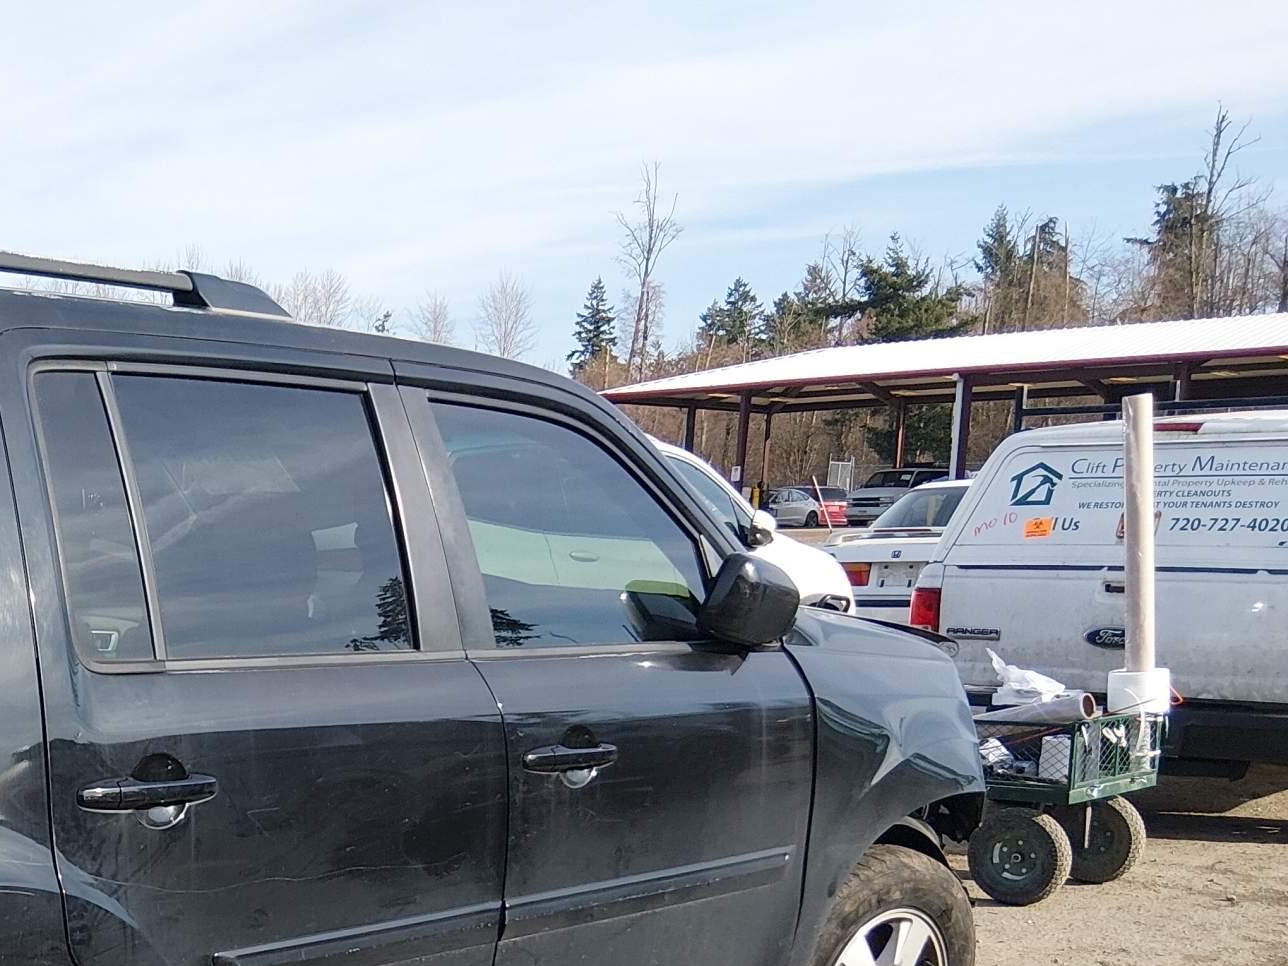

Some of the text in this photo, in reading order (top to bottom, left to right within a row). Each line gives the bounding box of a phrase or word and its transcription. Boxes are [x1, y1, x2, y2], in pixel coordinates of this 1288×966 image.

[1071, 458, 1108, 474] Clift
[1112, 458, 1187, 475] Perty
[1172, 479, 1214, 488] Property
[1216, 478, 1256, 487] Upkeep
[1175, 489, 1232, 498] CLEANOUTS
[1163, 501, 1188, 509] YOUR
[1190, 501, 1233, 509] TENANTS
[1234, 500, 1280, 509] DESTROY
[1062, 517, 1080, 531] Us
[1169, 517, 1288, 532] 720-727-4020
[946, 627, 999, 636] RANGER
